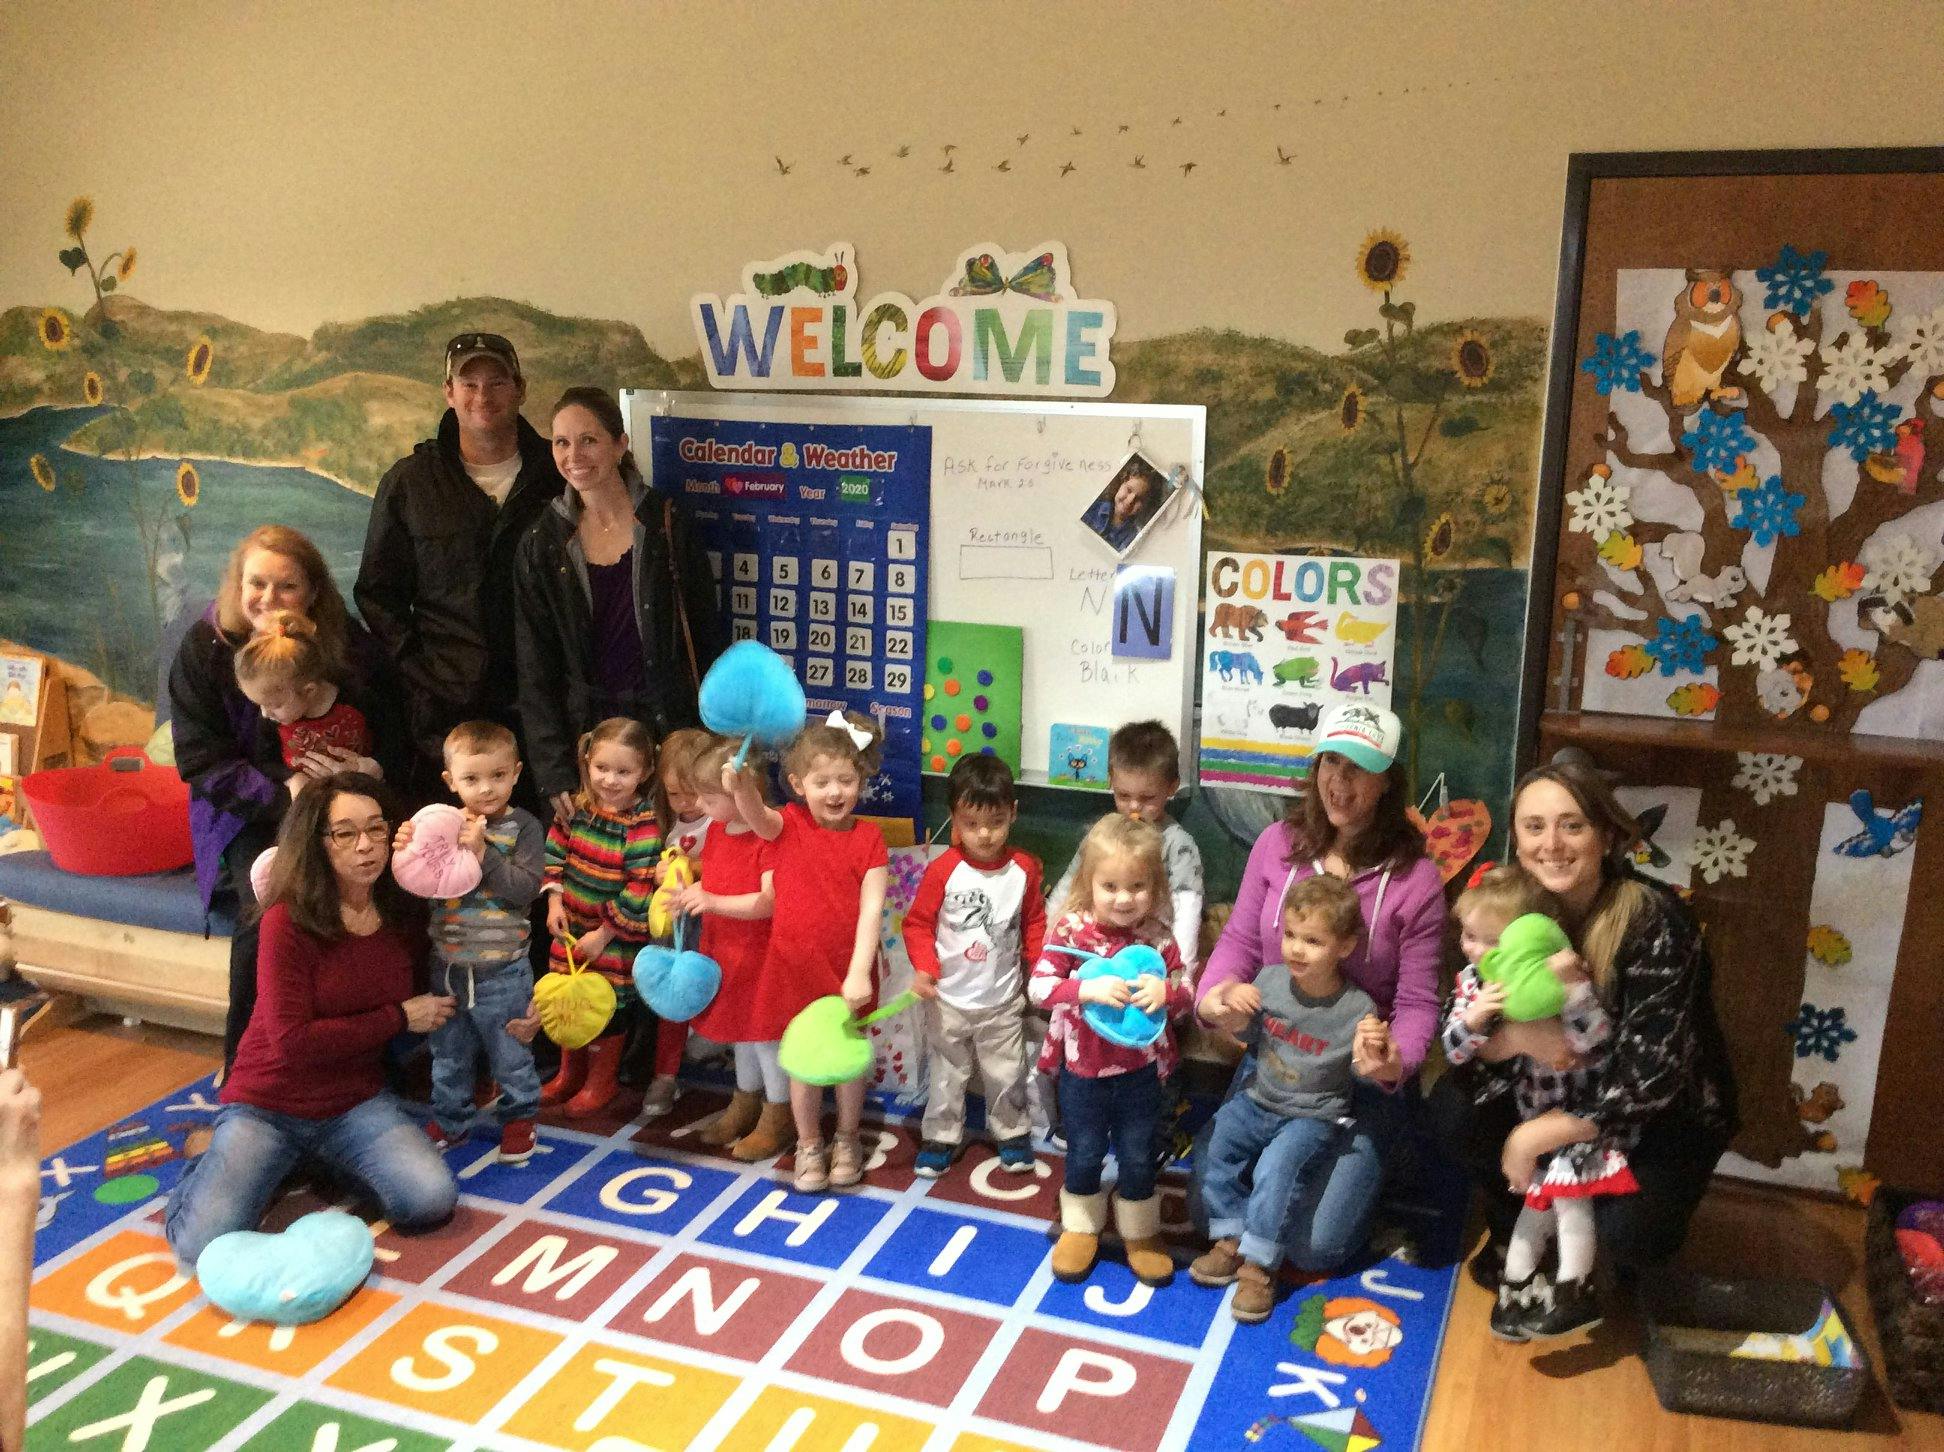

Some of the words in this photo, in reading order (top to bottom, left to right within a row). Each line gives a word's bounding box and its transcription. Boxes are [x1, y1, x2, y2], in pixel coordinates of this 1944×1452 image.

[699, 302, 1104, 386] WELCOME
[680, 437, 776, 466] Calendar
[781, 442, 799, 468] &
[804, 443, 897, 471] Weather
[744, 481, 785, 494] February
[799, 485, 826, 500] Year
[841, 482, 869, 495] 2020
[896, 538, 904, 554] 1
[970, 527, 1044, 545] Rectangle
[739, 560, 750, 577] 4
[778, 564, 789, 580] 5
[821, 565, 831, 581] 6
[854, 568, 865, 584] 7
[894, 571, 906, 587] 8
[1211, 556, 1395, 606] COLORS
[736, 593, 749, 609] 11
[772, 595, 789, 612] 12
[812, 598, 830, 615] 13
[850, 601, 868, 618] 14
[889, 604, 907, 621] 15
[1080, 583, 1108, 616] N
[1119, 575, 1164, 646] N
[735, 624, 750, 640] 18
[772, 627, 790, 644] 19
[810, 630, 831, 647] 20
[849, 634, 866, 651] 21
[887, 637, 908, 654] 22
[1071, 638, 1111, 656] Color
[808, 663, 829, 680] 27
[847, 667, 868, 684] 28
[886, 671, 907, 688] 29
[968, 1155, 1053, 1201] C
[600, 1166, 692, 1215] G
[734, 1190, 839, 1247] H
[928, 1225, 978, 1277] I
[1360, 1269, 1425, 1300] J
[491, 1234, 620, 1301] M
[643, 1266, 761, 1336] N
[839, 1308, 946, 1375] O
[1036, 1348, 1138, 1413] P
[85, 1252, 195, 1320] Q
[390, 1324, 499, 1392] S
[573, 1357, 676, 1432] T
[1267, 1362, 1347, 1407] K
[67, 1375, 217, 1452] X
